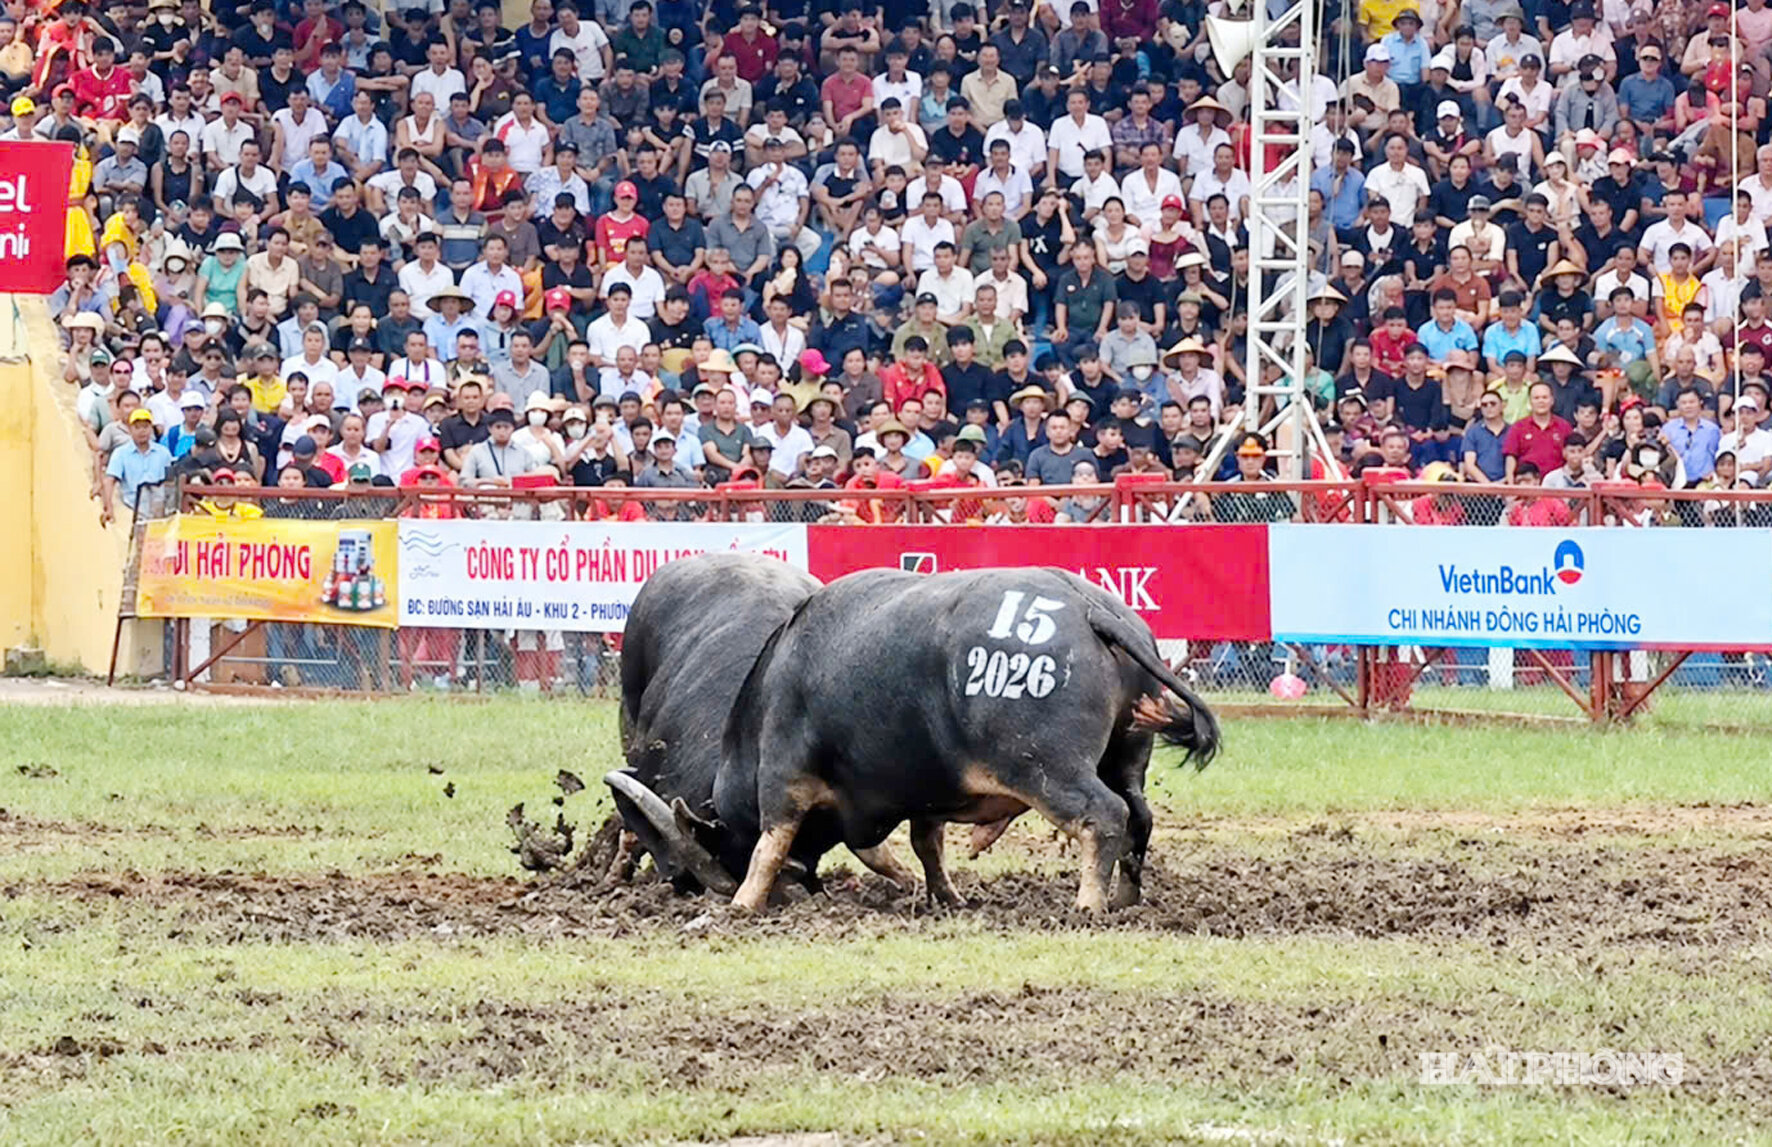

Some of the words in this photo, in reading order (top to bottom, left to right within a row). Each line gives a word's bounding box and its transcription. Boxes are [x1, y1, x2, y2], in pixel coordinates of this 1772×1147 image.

[197, 533, 230, 579] HẢI
[467, 539, 514, 580] CÔNG
[519, 547, 540, 580] TY
[545, 534, 570, 582] CỔ
[576, 536, 626, 583] PHẦN
[1080, 566, 1161, 611] NK
[1438, 564, 1556, 595] VietinBank
[544, 603, 568, 619] KHU
[571, 603, 579, 619] 2
[986, 590, 1066, 645] 15
[1388, 608, 1417, 630] CHI
[1422, 605, 1481, 631] NHÁNH
[1486, 606, 1539, 632] ĐÔNG
[1543, 605, 1572, 633] HẢI
[1577, 608, 1642, 634] PHÒNG
[965, 646, 1057, 699] 2026
